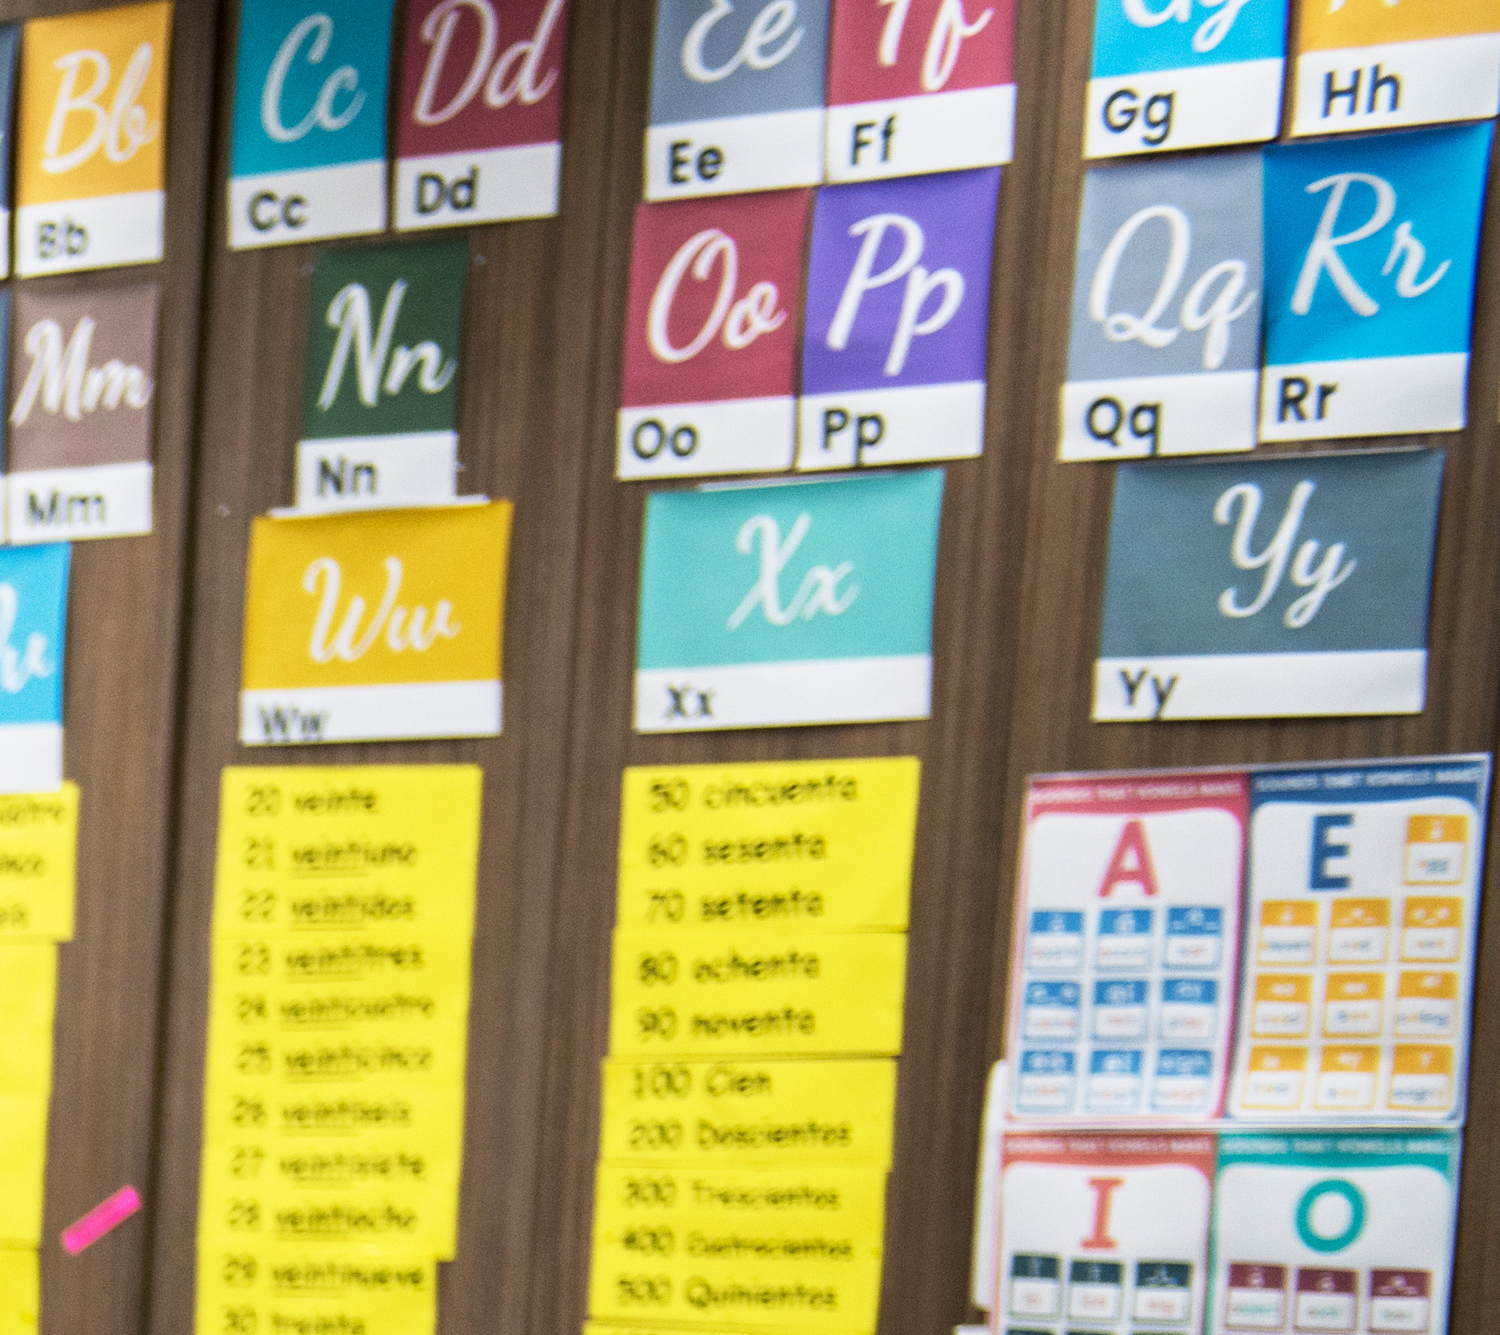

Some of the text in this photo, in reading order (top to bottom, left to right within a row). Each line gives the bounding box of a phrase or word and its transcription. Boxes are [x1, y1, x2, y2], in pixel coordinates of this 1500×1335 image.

[260, 12, 367, 144] Cc
[410, 0, 561, 127] Dd
[42, 42, 161, 174] Bb
[1100, 87, 1178, 146] Gg
[1322, 66, 1402, 119] Hh
[667, 139, 727, 186] Ee
[848, 118, 899, 170] Ff
[248, 189, 308, 232] Cc
[415, 165, 480, 214] Dd
[37, 222, 89, 260] Bb
[1291, 172, 1452, 318] Rr
[646, 228, 788, 364] Oo
[824, 213, 966, 378] Pp
[1088, 204, 1256, 370] Qq
[10, 315, 152, 427] Mm
[317, 279, 458, 413] Nn
[1086, 397, 1163, 457] Qq
[1276, 376, 1337, 425] Rr
[630, 419, 699, 461] Oo
[820, 408, 887, 465] Pp
[316, 456, 377, 498] Nn
[26, 490, 108, 529] Mm
[728, 512, 859, 632] Xx
[1213, 480, 1358, 629] Yy
[302, 555, 462, 664] Ww
[662, 682, 718, 722] Xx
[1118, 668, 1178, 721] Yy
[257, 704, 326, 744] Ww
[649, 773, 858, 811] 50 cincuenta
[647, 832, 827, 866] 60 sesenta
[1097, 819, 1159, 899] A
[1308, 813, 1355, 891] E
[646, 889, 824, 922] 70 setenta
[640, 951, 821, 984] 80 ochenta
[639, 1008, 816, 1040] 90 noventa
[632, 1063, 772, 1099] 100 Cien
[1080, 1177, 1124, 1250] I
[1294, 1178, 1367, 1253] O
